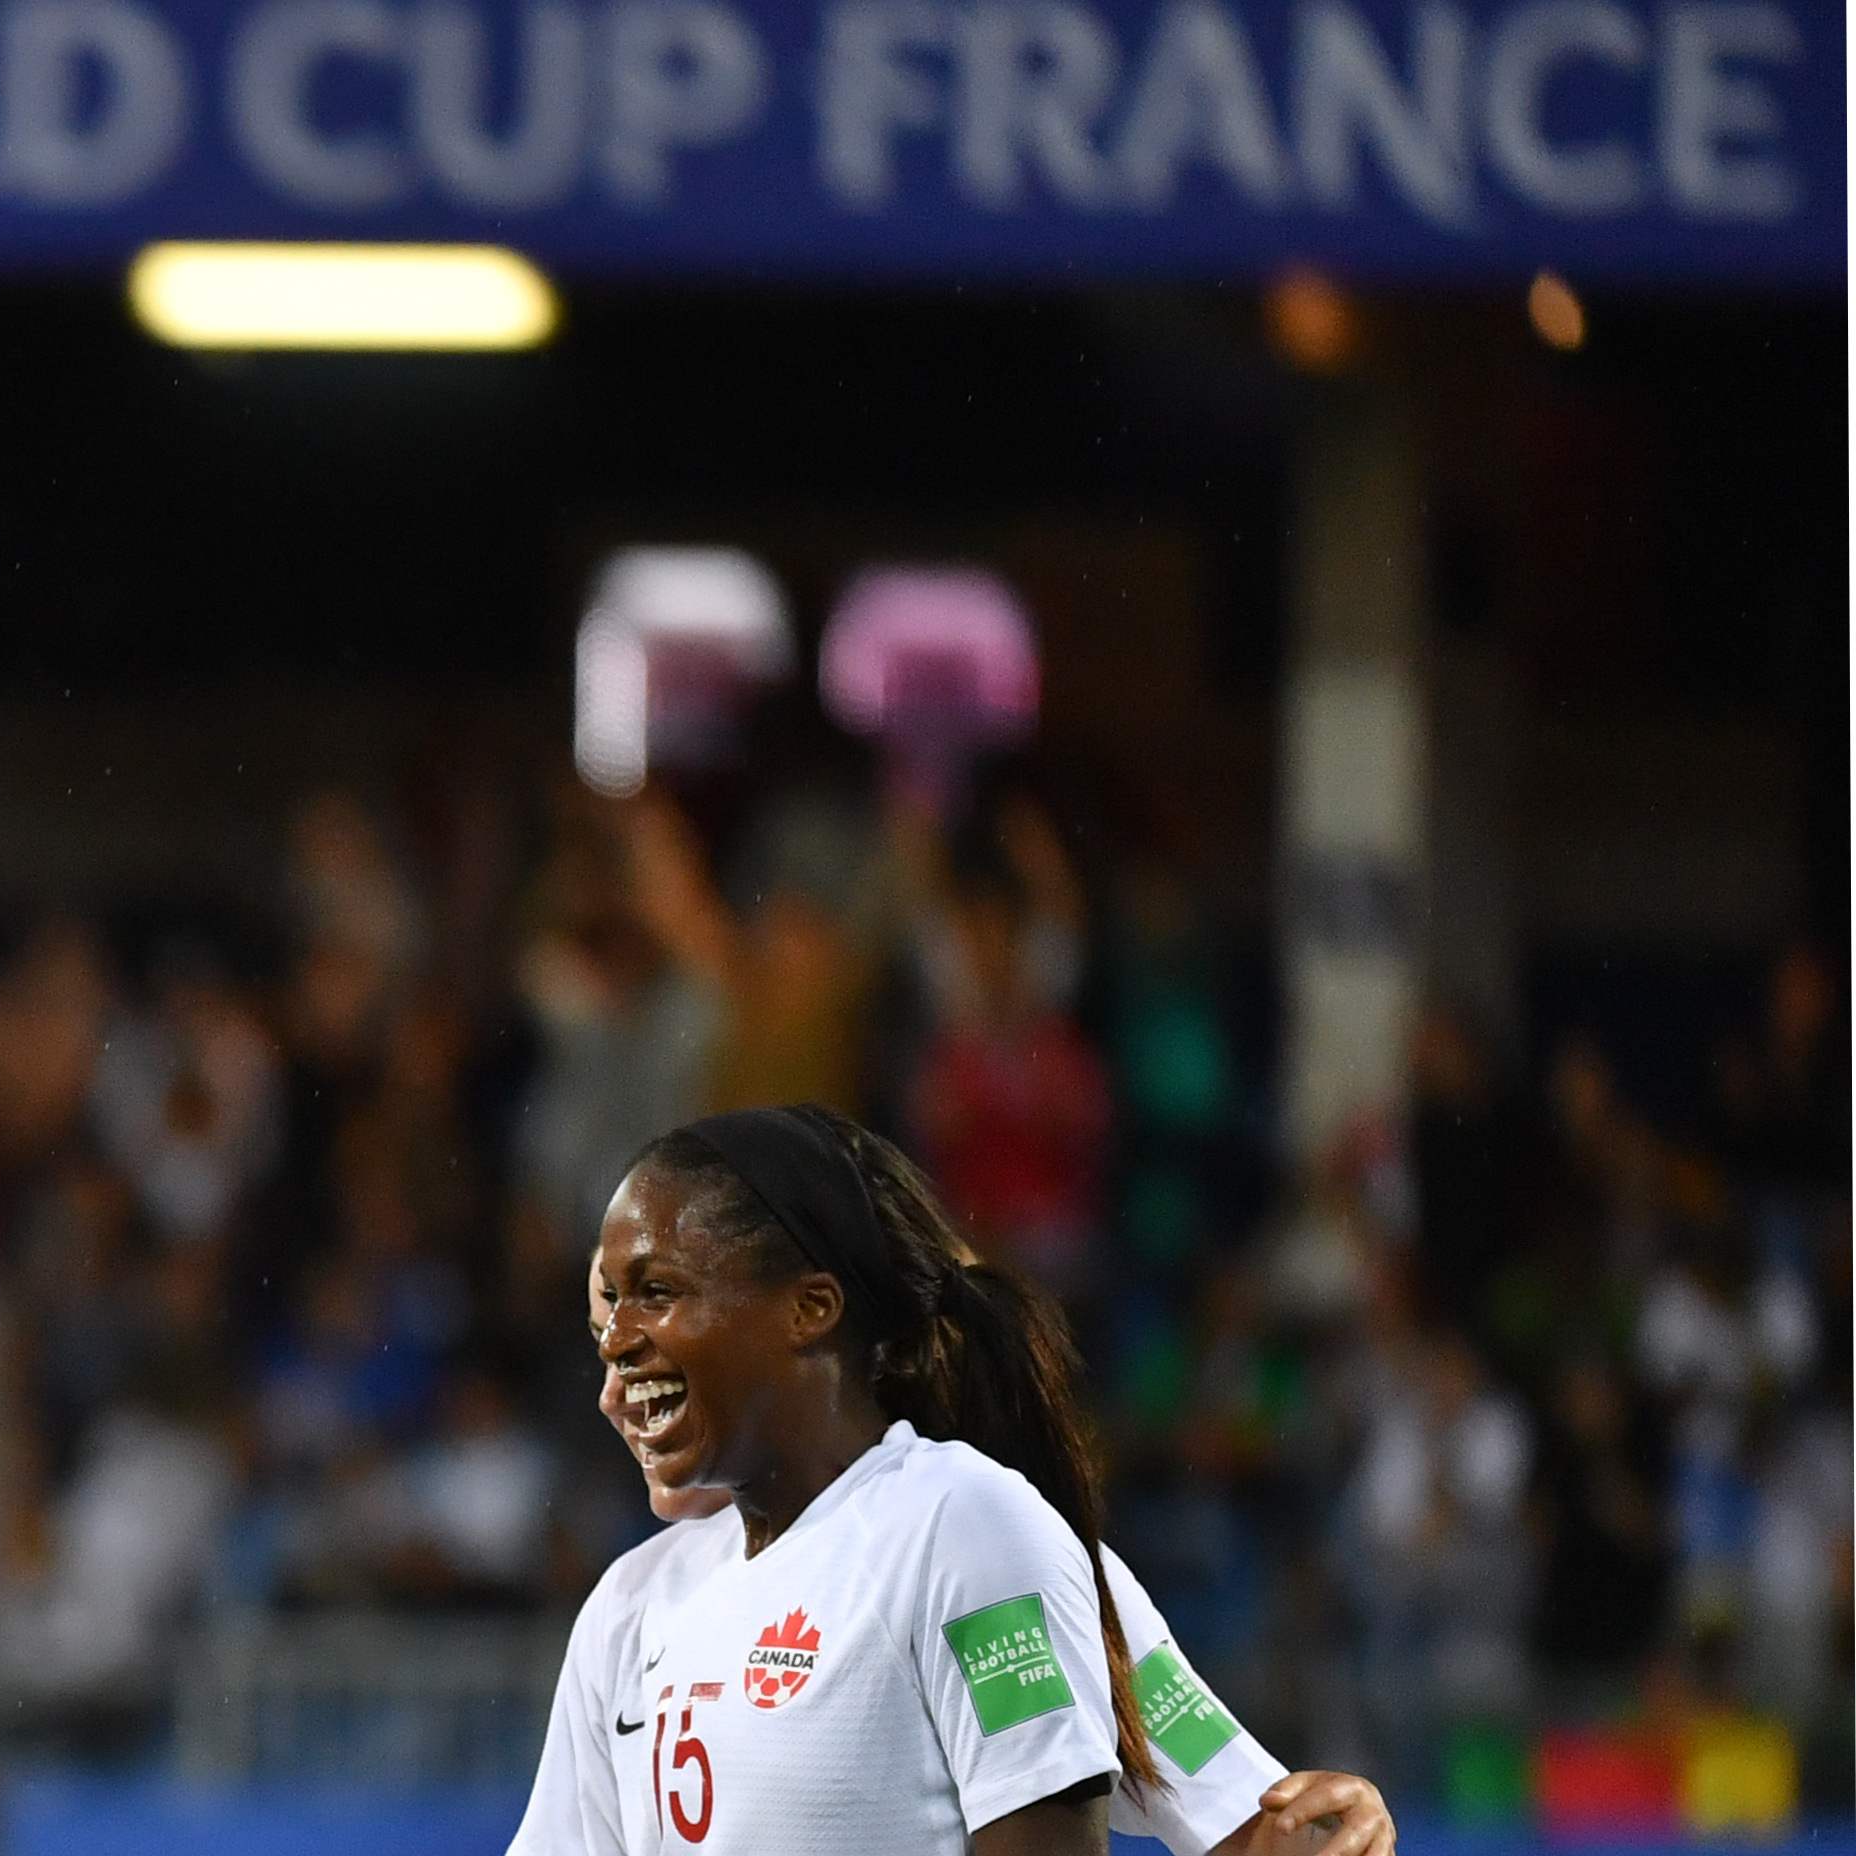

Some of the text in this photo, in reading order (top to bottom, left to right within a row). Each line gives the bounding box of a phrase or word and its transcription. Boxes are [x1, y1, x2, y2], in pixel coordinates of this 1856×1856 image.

[230, 0, 760, 206] CUP
[815, 0, 1794, 228] FRANCE
[747, 1649, 815, 1670] CANADA
[963, 1627, 1043, 1663] LIVING
[968, 1640, 1047, 1676] FOOTBALL
[1017, 1663, 1057, 1687] FIFA
[653, 1682, 726, 1844] 15
